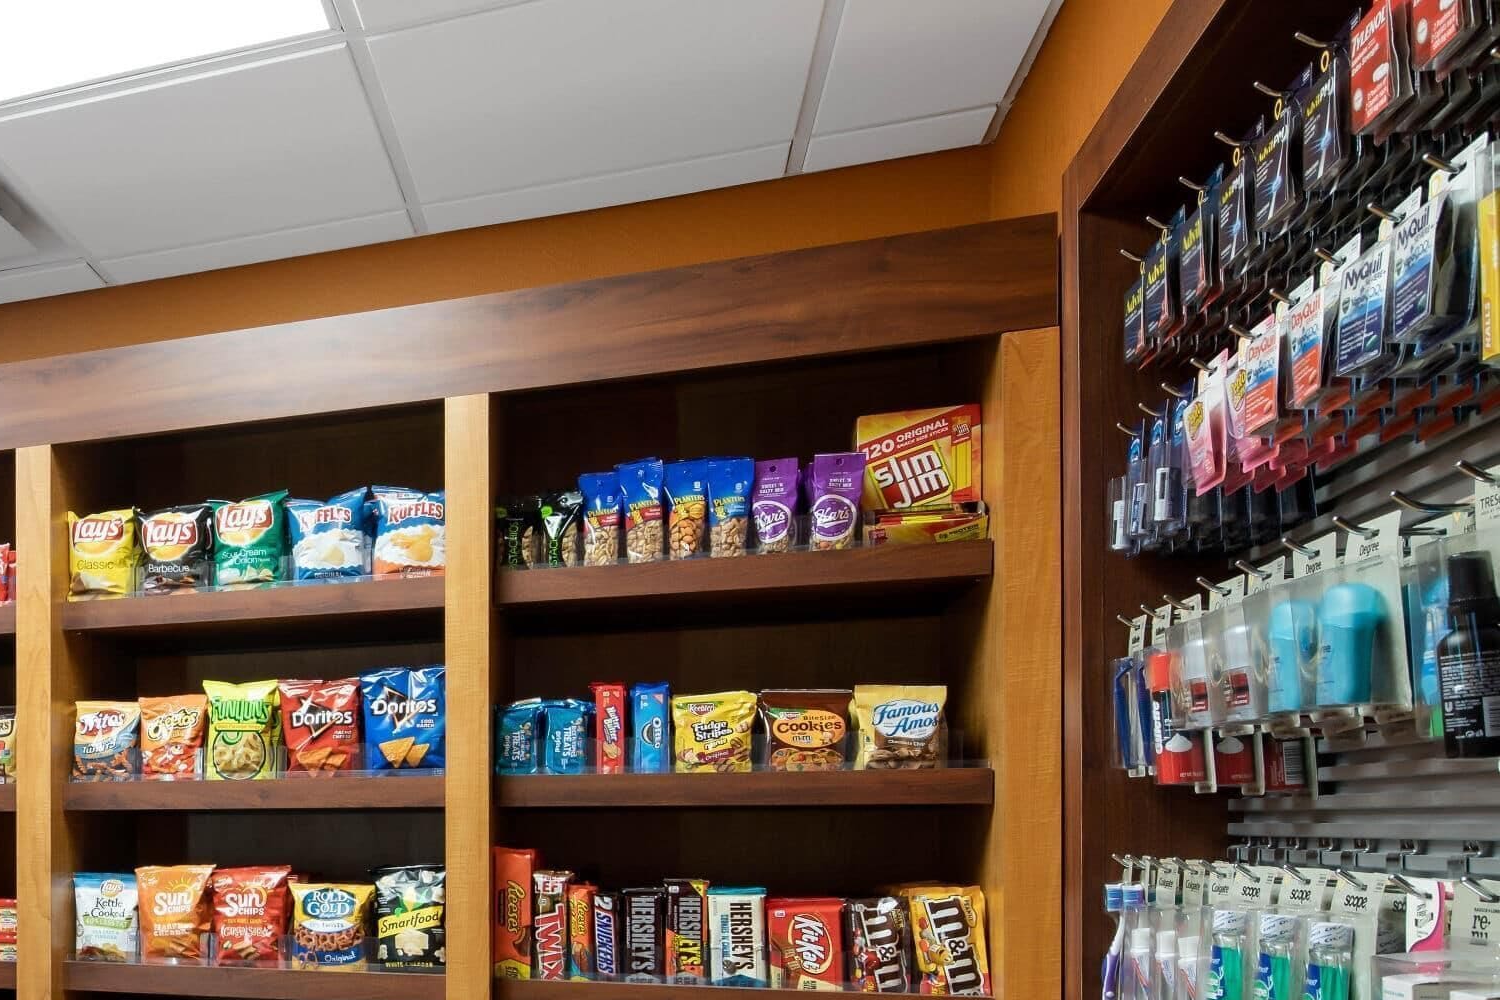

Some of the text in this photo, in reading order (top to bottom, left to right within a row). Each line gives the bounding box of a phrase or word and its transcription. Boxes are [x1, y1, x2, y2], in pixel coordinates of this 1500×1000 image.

[1351, 5, 1386, 52] TYLENOL
[1397, 205, 1430, 250] NyQuil
[1146, 255, 1165, 288] Advil
[1344, 251, 1382, 290] NyQuil
[1291, 295, 1321, 330] DayQuil
[863, 438, 895, 460] 120
[896, 418, 949, 443] ORIGINAL
[896, 438, 916, 449] SNACK
[927, 427, 949, 440] STICKS
[389, 500, 444, 523] RUFFLES
[815, 504, 850, 530] Kar's
[948, 524, 980, 536] PROTEIN
[239, 548, 267, 558] Cream
[1359, 541, 1380, 556] Degree
[76, 559, 114, 570] Classic
[148, 563, 190, 573] Barbecue
[1305, 560, 1322, 573] Degree
[371, 698, 437, 716] Doritos
[687, 703, 715, 714] Keebler
[873, 701, 940, 723] Famous
[291, 710, 353, 728] Doritos
[605, 706, 621, 730] Nutter
[691, 720, 727, 733] Fudge
[776, 719, 842, 734] Cookies
[886, 716, 940, 737] Amos
[652, 716, 662, 749] OREO
[695, 727, 733, 742] Stripes
[511, 732, 520, 761] TREATS
[563, 727, 572, 757] TREATS
[704, 750, 729, 762] Original
[1158, 877, 1174, 889] Colgate
[1185, 879, 1201, 891] Colgate
[1211, 884, 1230, 896] Colgate
[1242, 885, 1261, 899] scope
[95, 897, 123, 908] Kettle
[153, 892, 190, 916] Sun
[224, 892, 263, 917] Sun
[311, 889, 350, 902] ROLD
[1290, 889, 1311, 903] scope
[1344, 894, 1368, 910] scope
[90, 908, 125, 918] Cooked
[166, 905, 191, 913] CHIPS
[238, 906, 265, 916] CHIPS
[306, 901, 350, 916] GOLD
[380, 910, 440, 934] Smartfood
[631, 897, 655, 971] HERSHEY'S
[679, 896, 701, 967] HERSHEY'S
[730, 902, 754, 970] HERSHEY'S
[535, 903, 564, 980] TWIX
[596, 910, 614, 975] SNICKERS
[324, 950, 356, 964] Original
